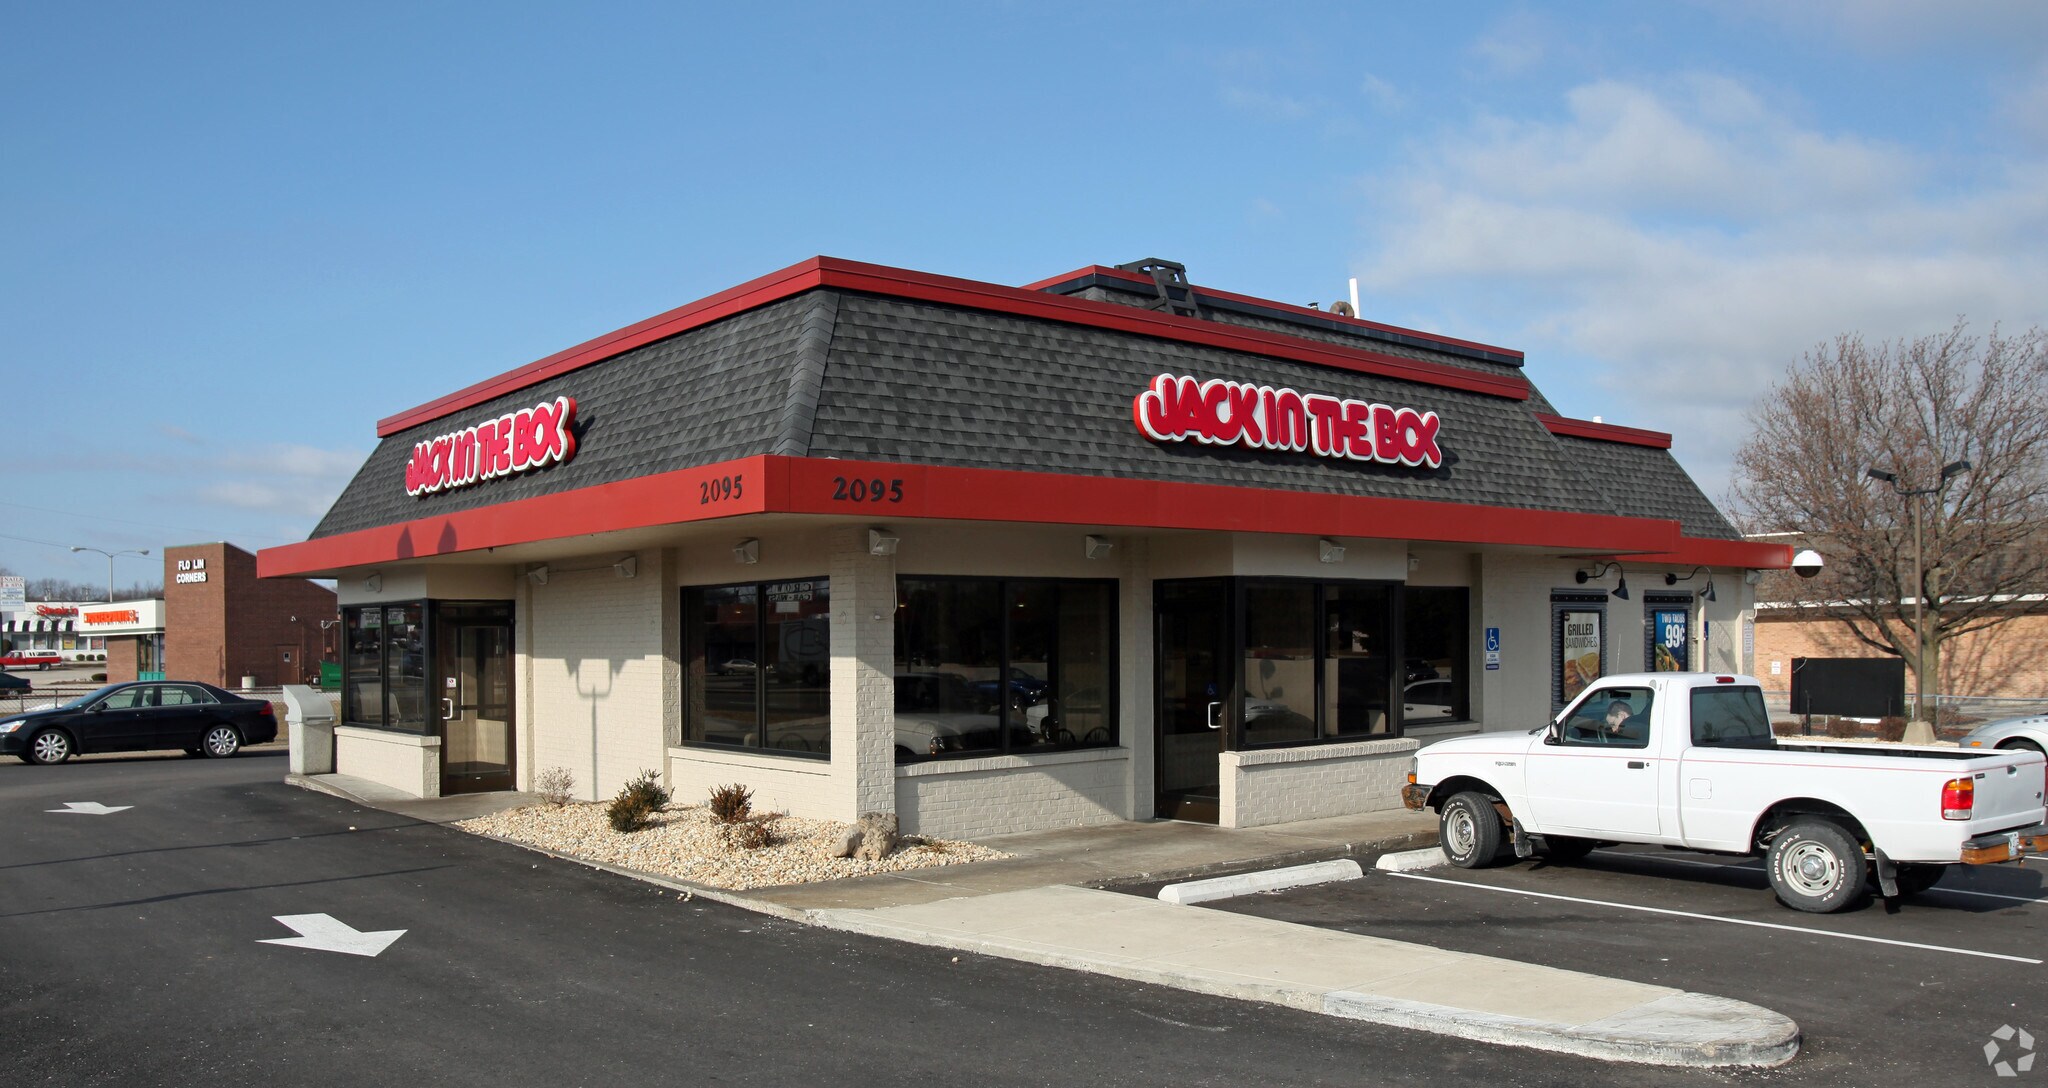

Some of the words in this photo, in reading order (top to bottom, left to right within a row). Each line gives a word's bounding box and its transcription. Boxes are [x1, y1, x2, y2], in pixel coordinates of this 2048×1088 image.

[1146, 376, 1264, 446] JACK
[1262, 389, 1307, 448] IN
[1307, 397, 1374, 458] THE
[1373, 407, 1442, 467] BOX
[405, 434, 454, 494] JACK
[452, 429, 476, 483] IN
[476, 416, 512, 477] THE
[512, 400, 565, 467] BOX
[700, 474, 743, 504] 2095
[832, 476, 904, 503] 2095
[176, 572, 207, 583] CORNERS
[178, 560, 191, 571] FLO
[193, 558, 205, 570] LIN
[1567, 623, 1594, 635] GRILLED
[1661, 613, 1672, 624] TWO
[1672, 613, 1686, 624] TACOS
[1565, 636, 1598, 649] SANDWICHES
[1665, 624, 1686, 649] 99¢
[1774, 852, 1782, 882] ROAD
[1779, 833, 1801, 850] MAX
[1836, 859, 1845, 891] DELTA
